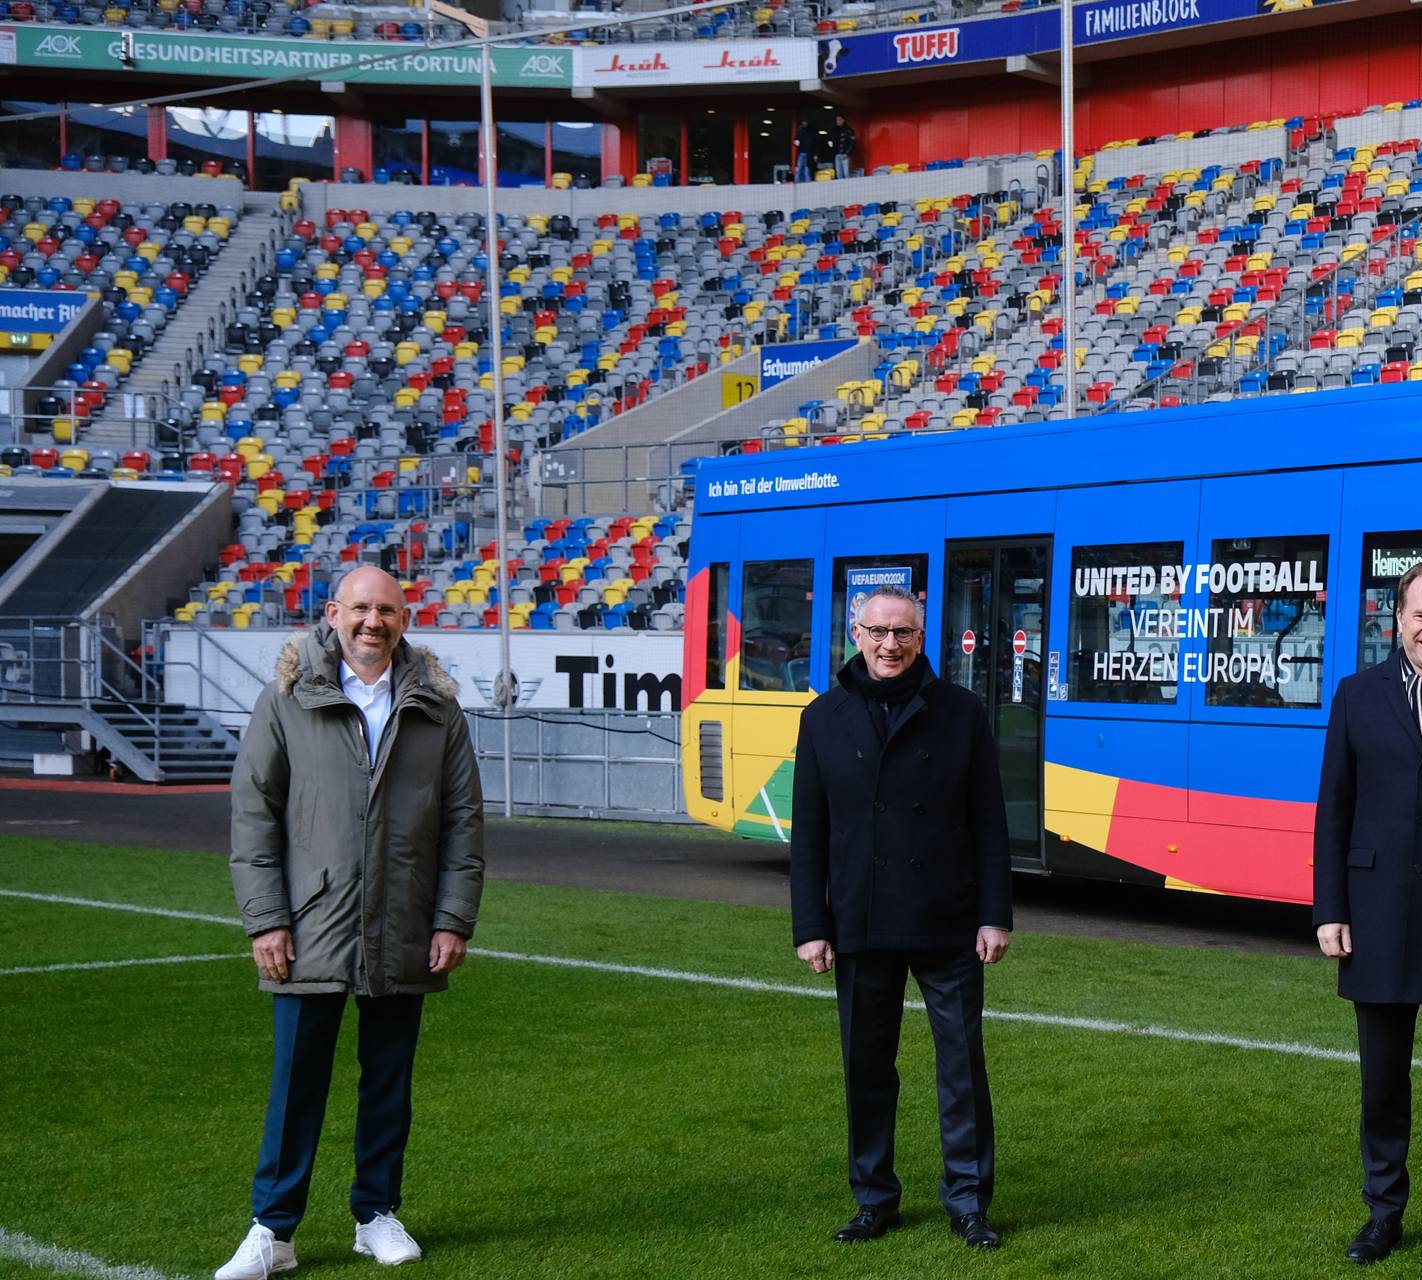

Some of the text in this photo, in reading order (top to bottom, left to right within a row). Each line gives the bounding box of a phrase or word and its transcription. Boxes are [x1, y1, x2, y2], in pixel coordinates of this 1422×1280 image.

[36, 35, 81, 53] AOK
[894, 28, 959, 63] TUFFI
[359, 53, 398, 71] DER
[521, 55, 564, 74] AOK
[762, 356, 826, 379] Schumac
[736, 381, 754, 403] 12
[708, 472, 840, 498] Ich bin Teil der Umweltflotte.
[1075, 560, 1324, 597] UNITED BY FOOTBALL
[1129, 605, 1254, 638] VEREINT IM
[1093, 651, 1178, 681] HERZEN
[1183, 652, 1292, 685] EUROPAS
[556, 654, 682, 711] Tim
